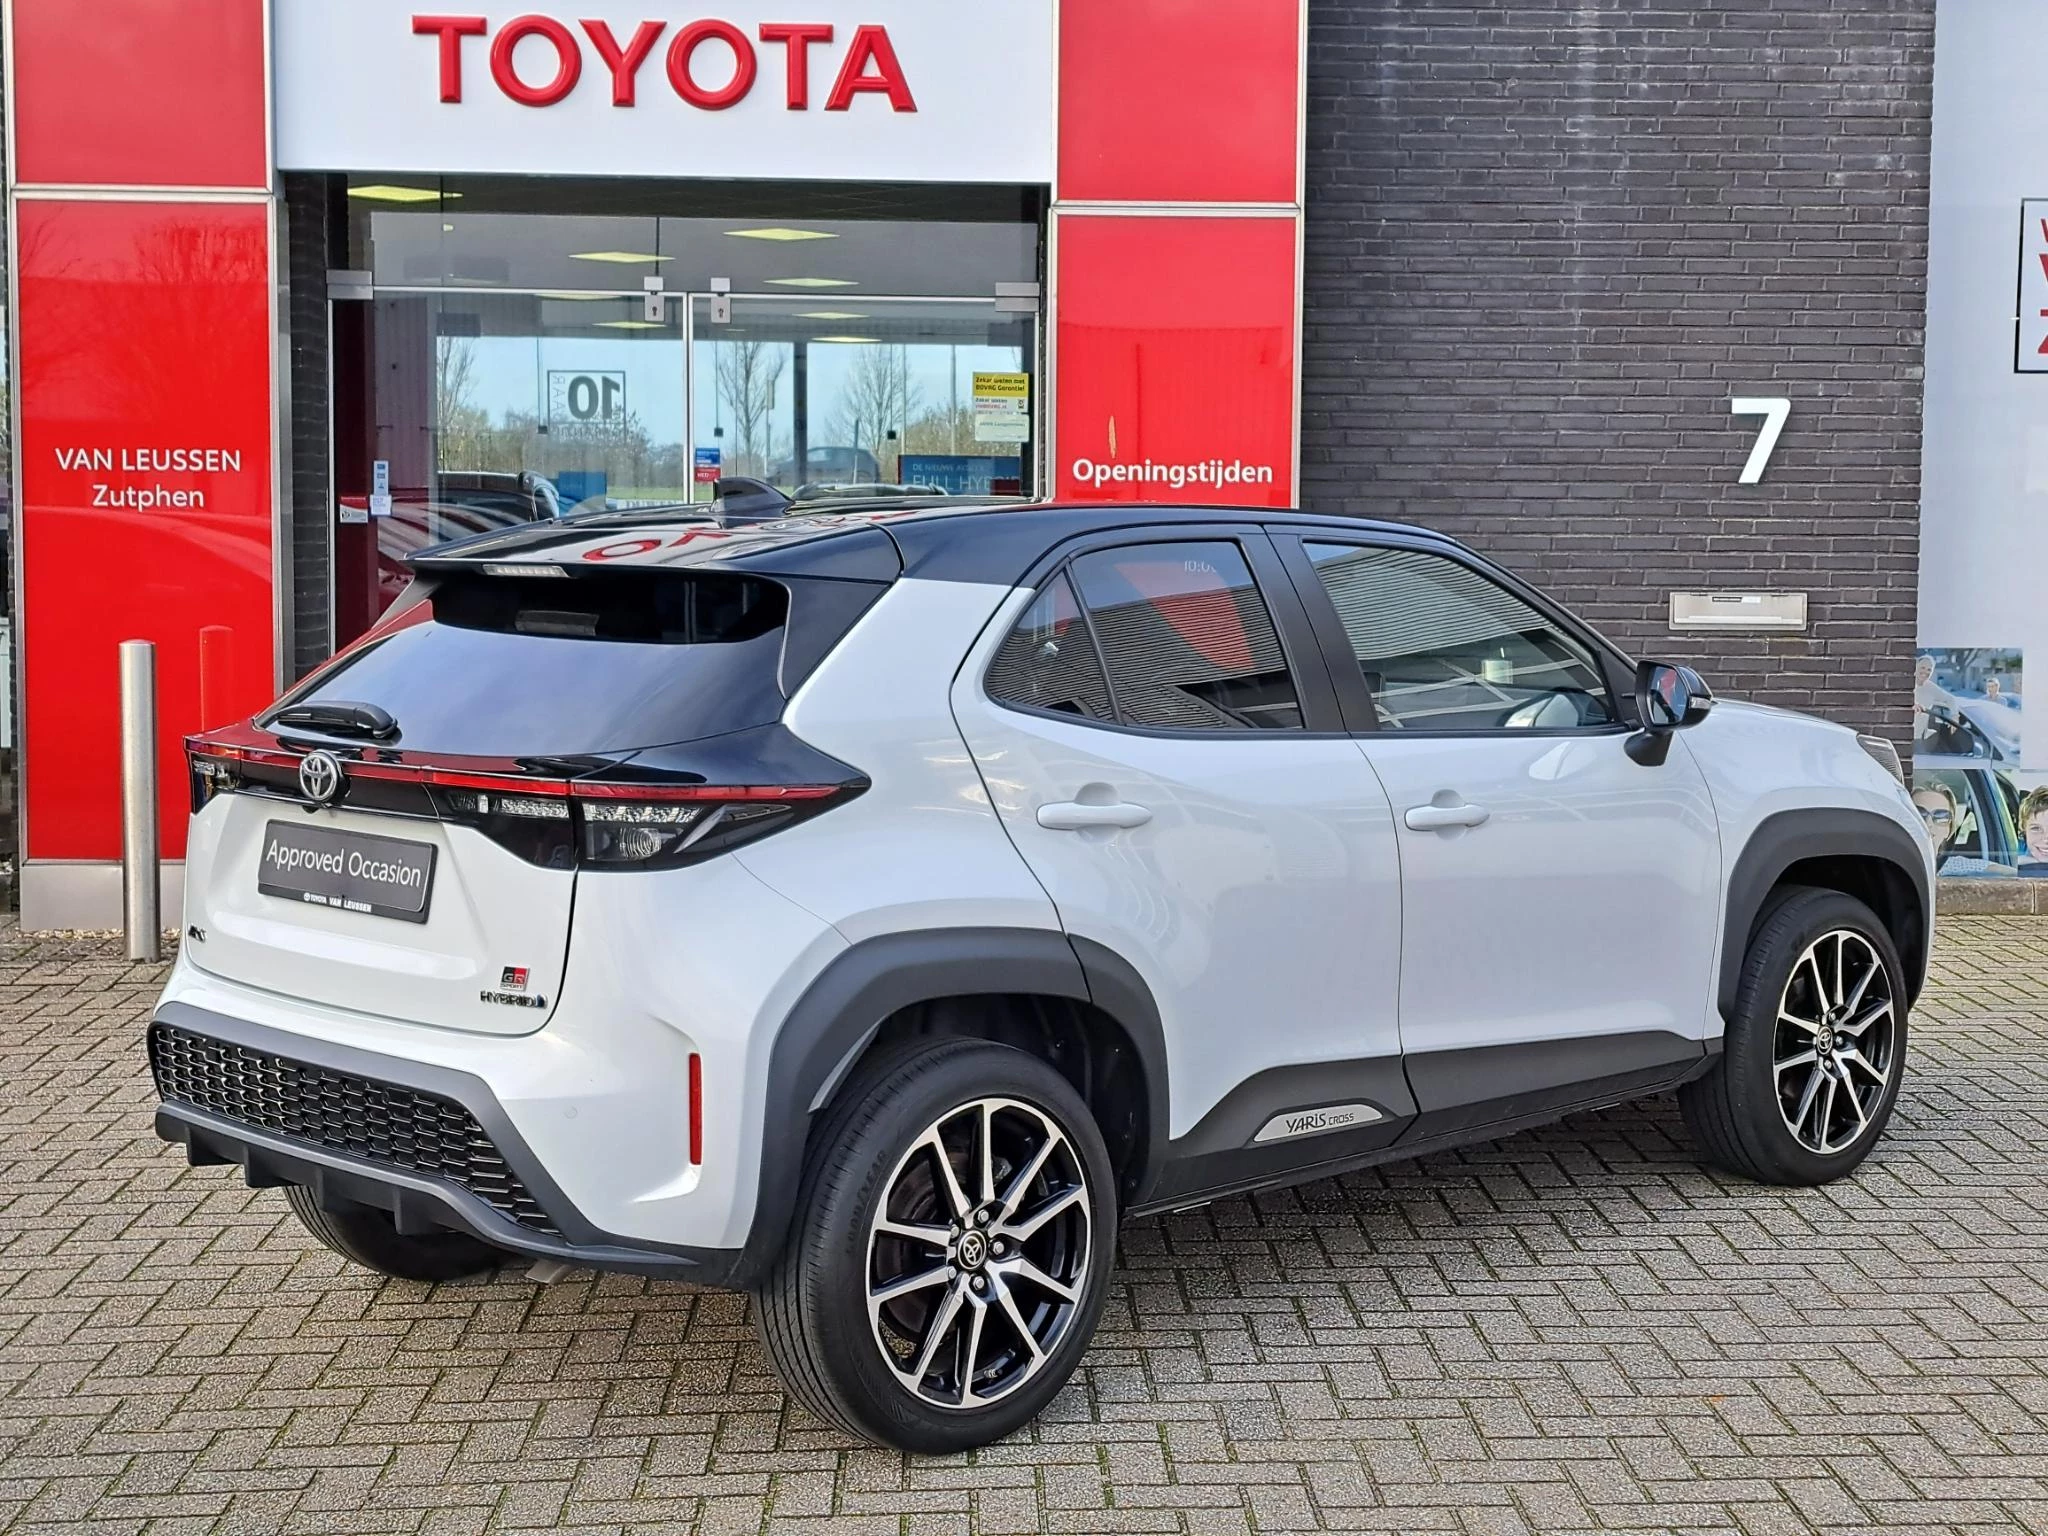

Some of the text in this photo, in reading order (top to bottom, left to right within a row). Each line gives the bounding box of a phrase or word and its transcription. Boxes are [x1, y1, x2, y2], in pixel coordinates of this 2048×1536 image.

[411, 14, 918, 113] TOYOTA
[1731, 398, 1791, 484] 7
[55, 447, 241, 473] VAN LEUSSEN
[1072, 458, 1274, 489] Openingstijden
[92, 484, 205, 513] Zutphen
[266, 839, 422, 888] Approved Occasion
[329, 896, 342, 908] VAN
[343, 899, 372, 913] LEUSSEN
[503, 973, 525, 985] GR
[480, 990, 537, 1008] HYBRID
[1285, 1112, 1355, 1134] YARIS CROSS
